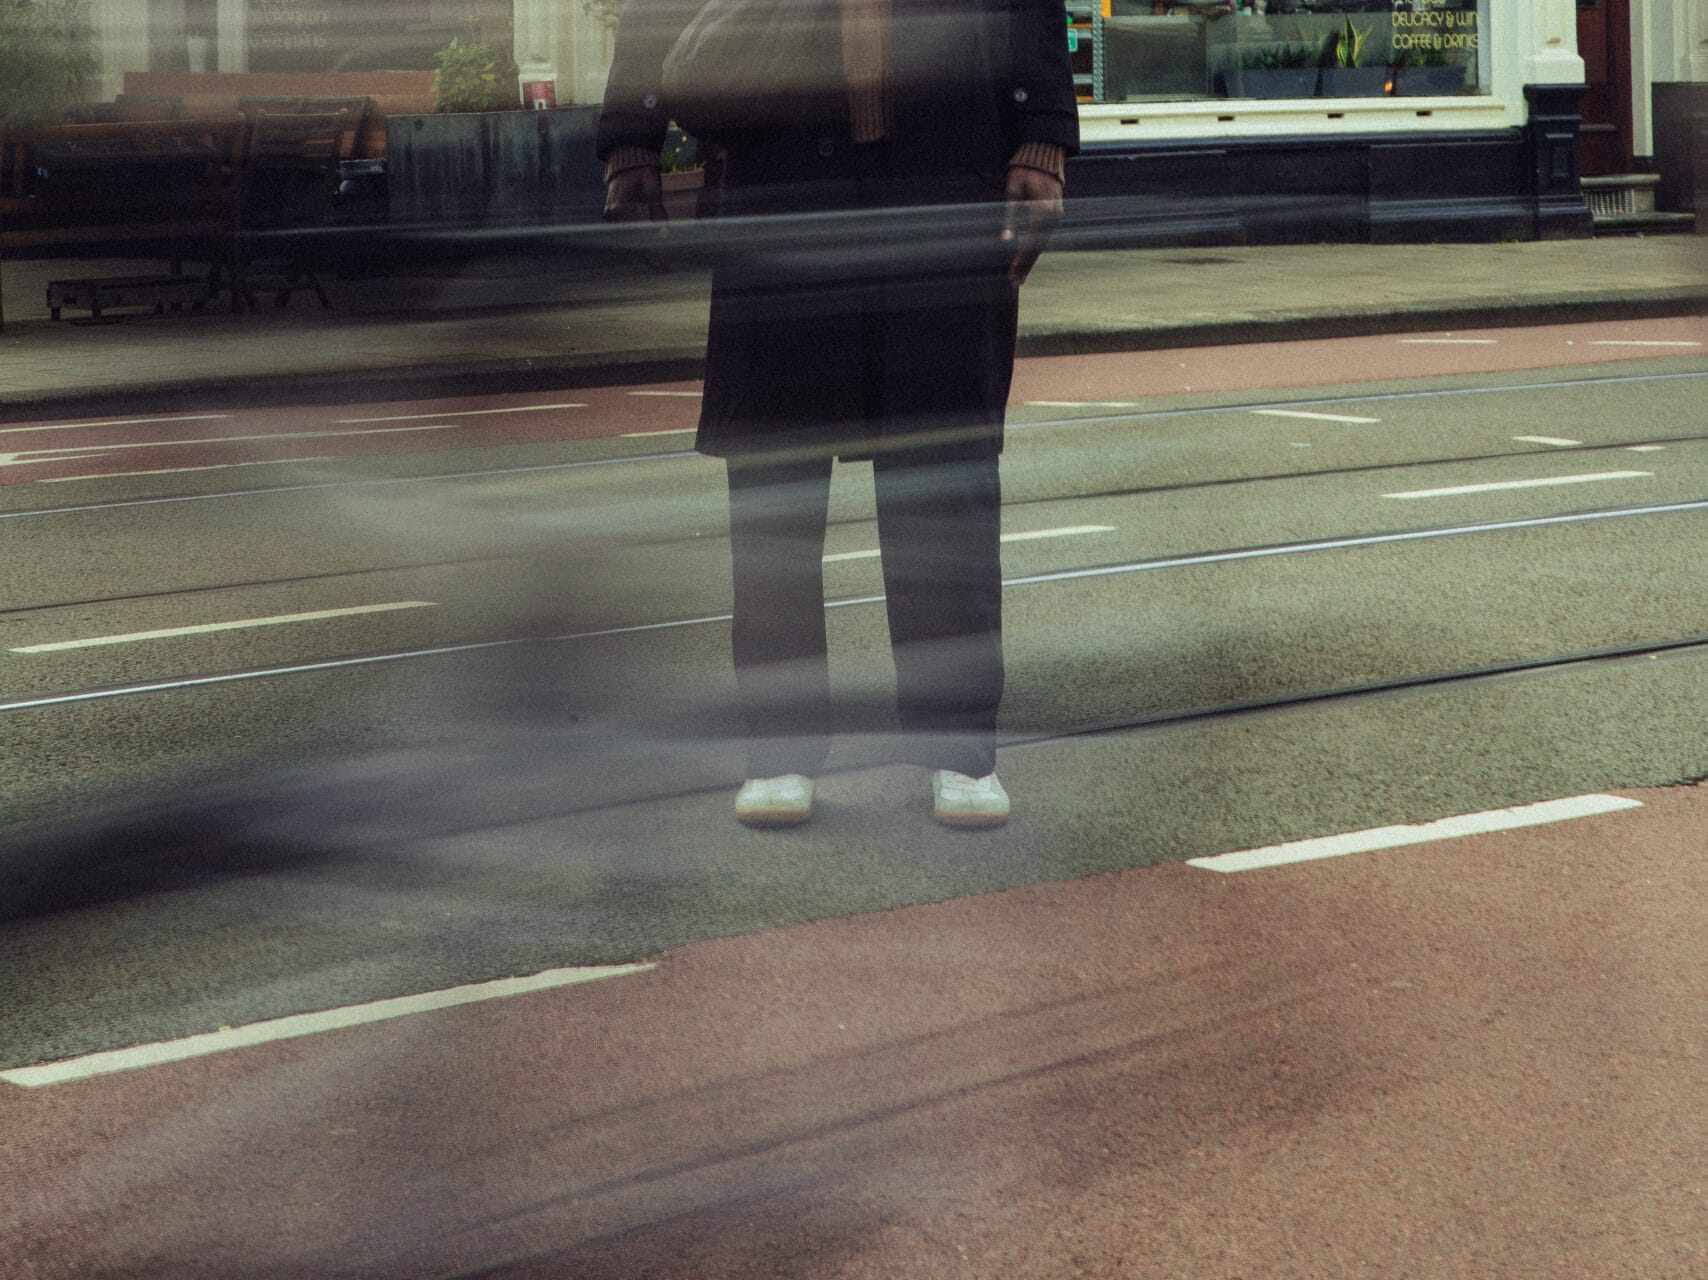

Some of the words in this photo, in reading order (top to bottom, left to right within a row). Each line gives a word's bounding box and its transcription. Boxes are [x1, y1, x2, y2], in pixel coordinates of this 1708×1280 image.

[1391, 11, 1445, 27] DELICACY
[1446, 10, 1455, 28] &
[1392, 33, 1432, 49] COFFEE
[1433, 33, 1442, 51] &
